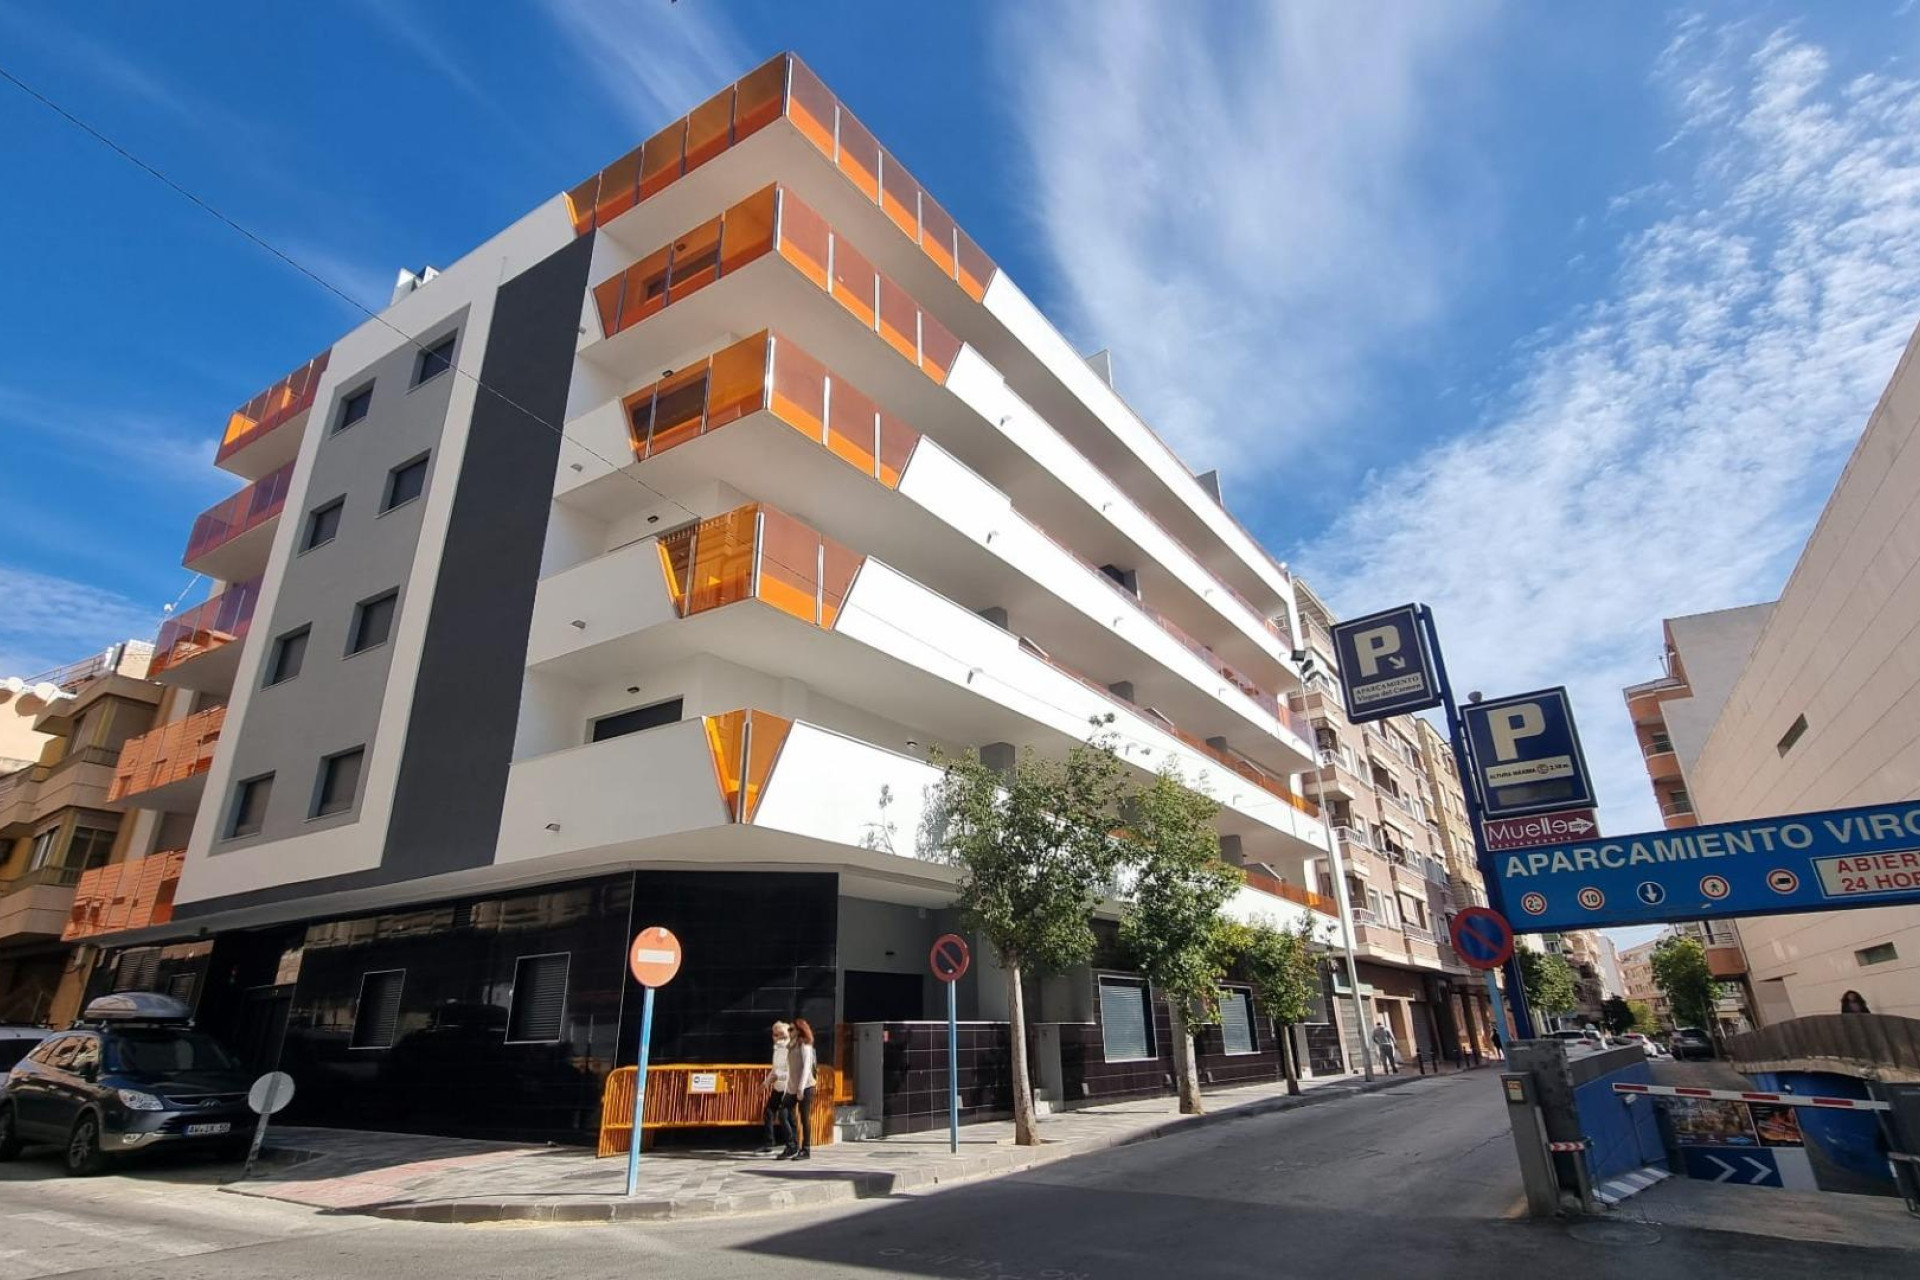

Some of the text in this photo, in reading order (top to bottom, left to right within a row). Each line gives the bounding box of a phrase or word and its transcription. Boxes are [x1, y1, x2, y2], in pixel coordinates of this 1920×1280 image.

[1353, 625, 1400, 677] P
[1356, 676, 1419, 695] APARCAMIENTO
[1487, 703, 1546, 761] P
[1488, 817, 1568, 841] Muelle
[1505, 823, 1814, 878] APARCAMIENTO
[1838, 852, 1920, 874] ABIER
[1841, 876, 1868, 892] 24
[1585, 893, 1598, 904] 10
